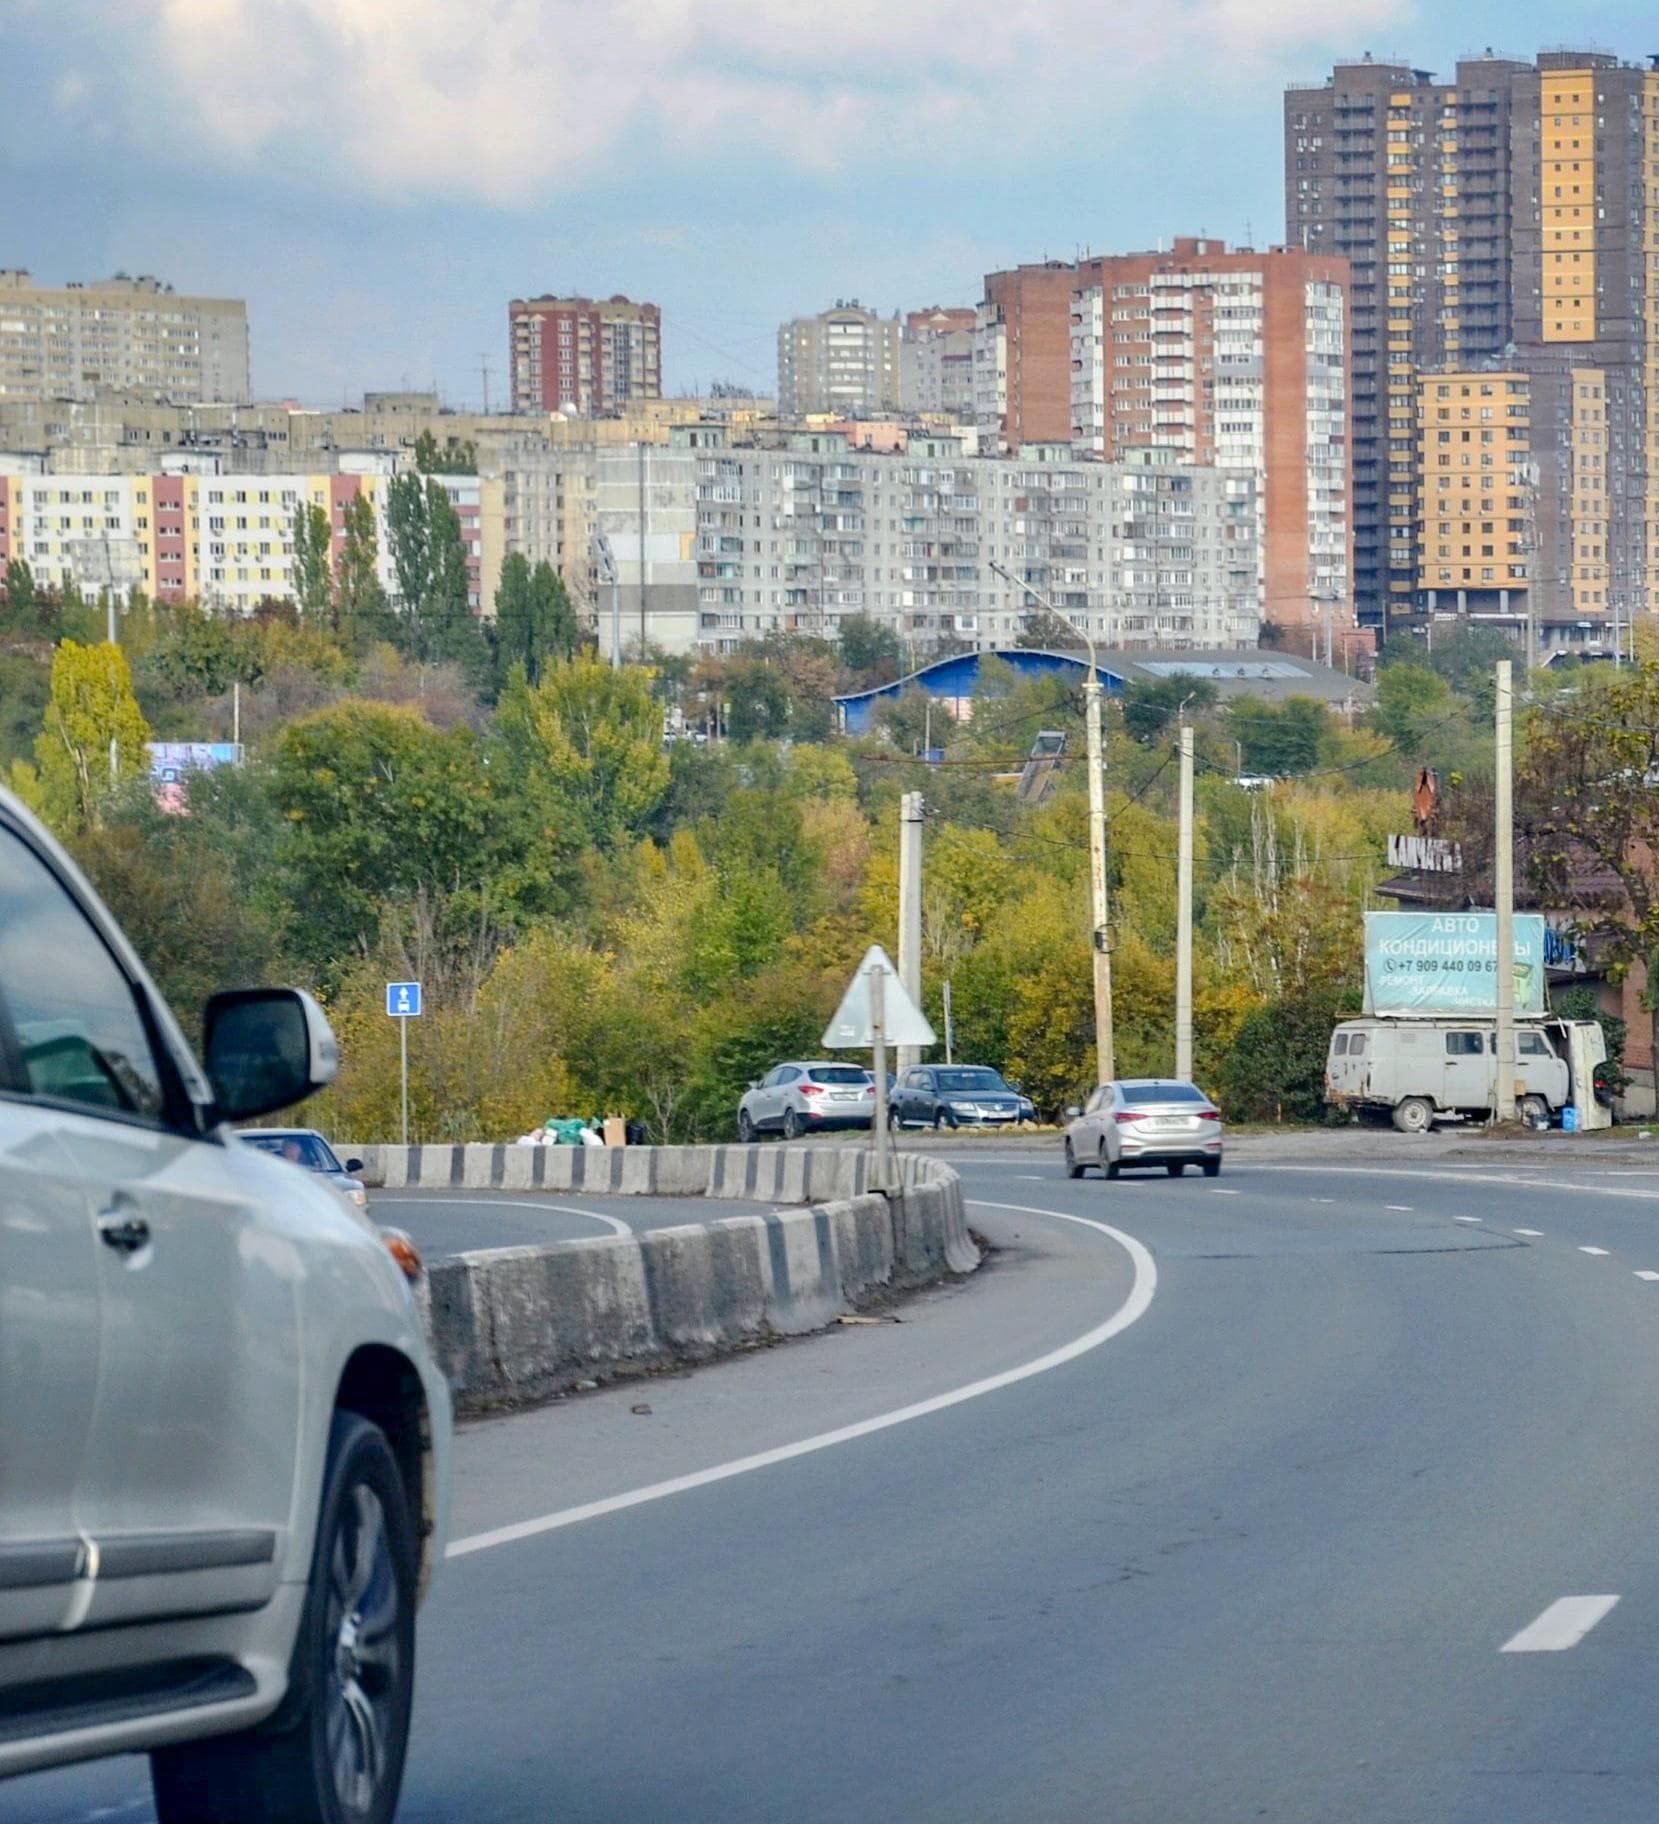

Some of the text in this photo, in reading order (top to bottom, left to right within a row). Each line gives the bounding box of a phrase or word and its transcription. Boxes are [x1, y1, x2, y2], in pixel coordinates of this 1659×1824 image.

[1432, 917, 1480, 933] АВТО
[1379, 938, 1531, 957] КОНДИЦИОНЕЫ
[1398, 960, 1412, 972] +7
[1416, 960, 1438, 972] 909
[1442, 960, 1464, 972] 440
[1467, 960, 1482, 972] 09
